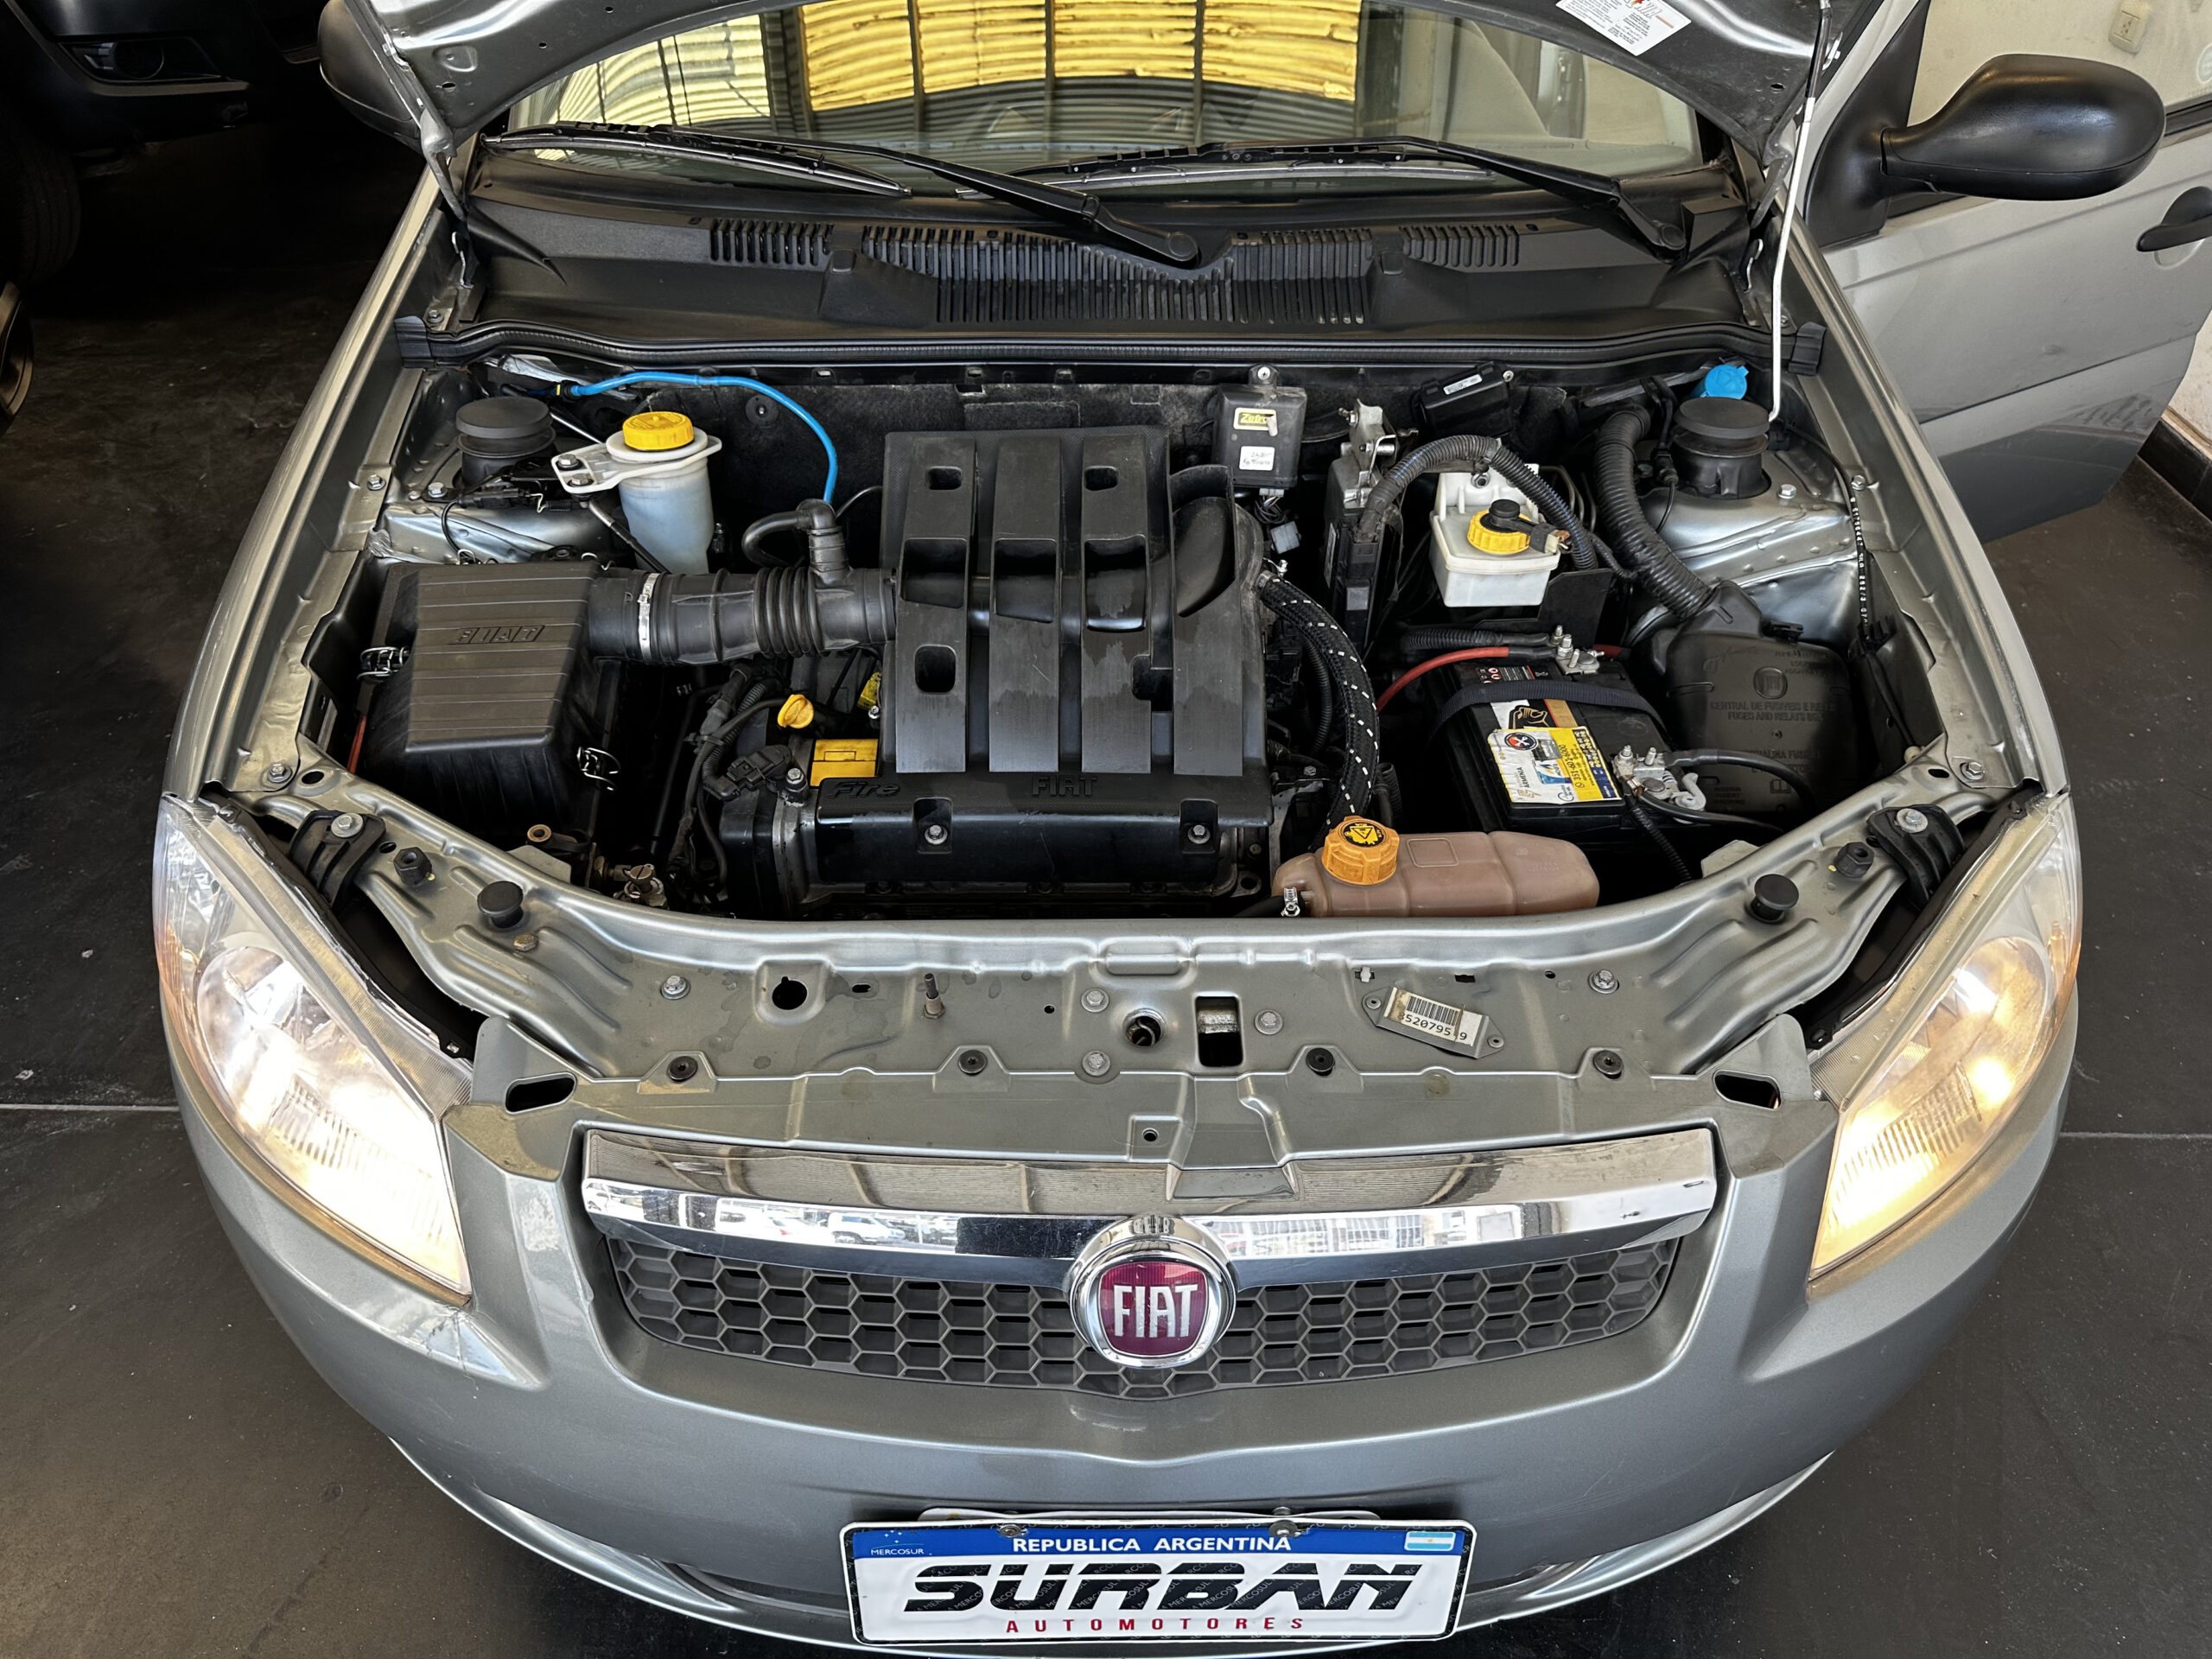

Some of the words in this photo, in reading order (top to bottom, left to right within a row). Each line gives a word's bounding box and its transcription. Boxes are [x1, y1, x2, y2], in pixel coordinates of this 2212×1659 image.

[451, 626, 543, 645] FIAT
[828, 781, 900, 798] Fire
[1032, 776, 1099, 797] FIAT
[1459, 1032, 1467, 1040] 9
[1113, 1284, 1198, 1338] FIAT
[1013, 1538, 1141, 1552] REPUBLICA
[1154, 1537, 1292, 1552] ARGENTINA
[904, 1562, 1422, 1612] SURBAN
[1006, 1618, 1303, 1633] AUTOMOTORES
